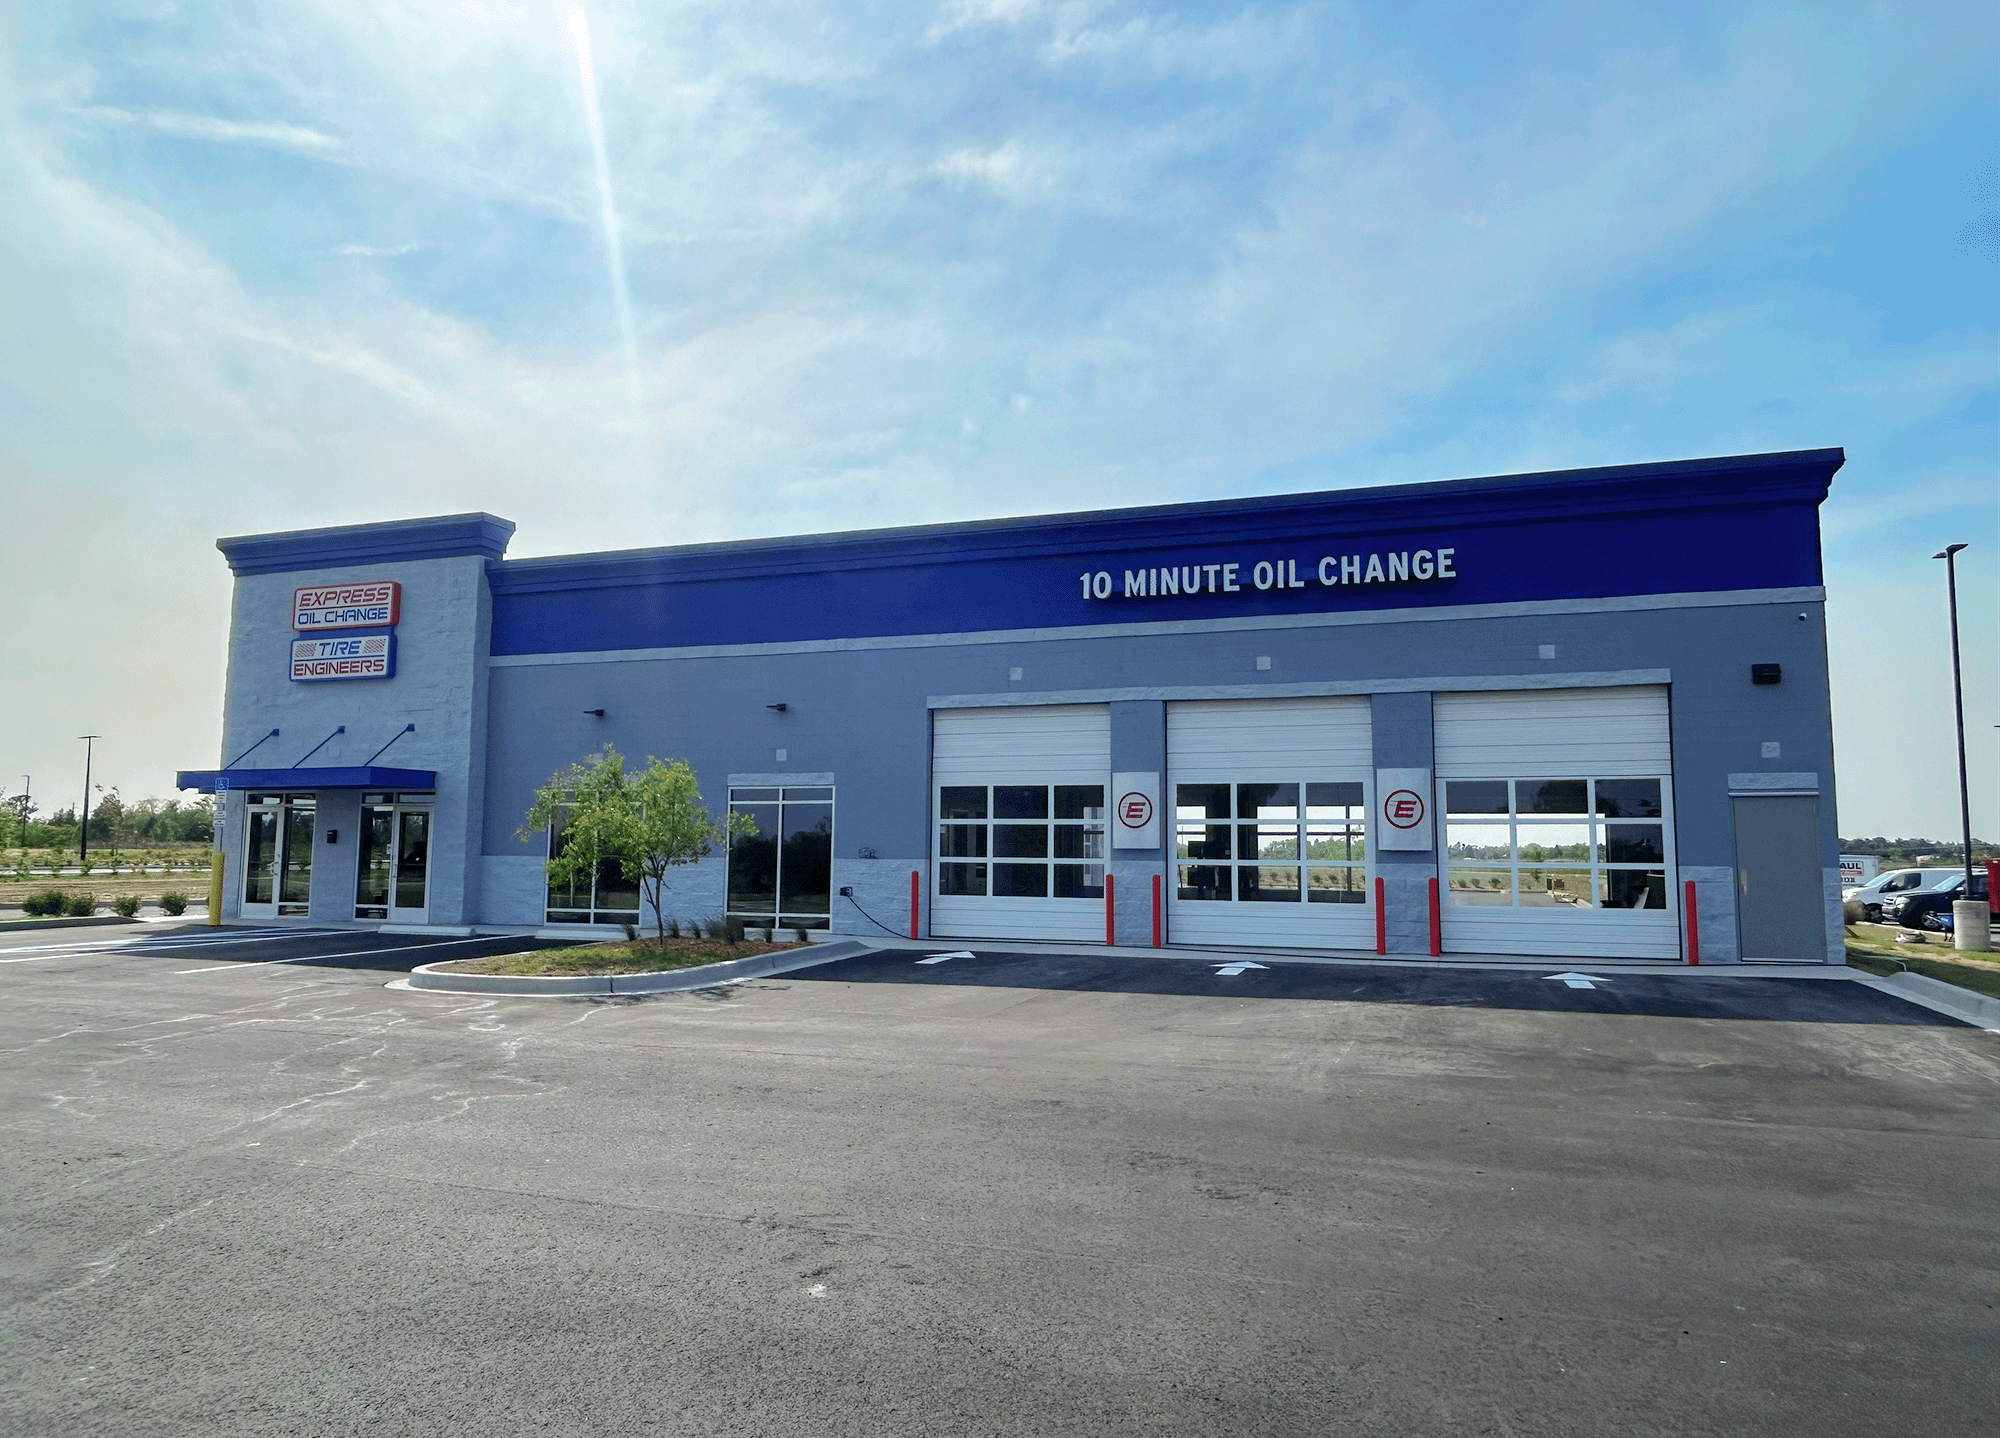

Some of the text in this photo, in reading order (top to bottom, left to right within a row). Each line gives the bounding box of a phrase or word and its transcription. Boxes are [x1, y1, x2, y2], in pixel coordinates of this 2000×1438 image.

[1079, 548, 1457, 600] 10 MINUTE OIL CHANGE
[299, 586, 391, 607] EXPRESS
[298, 607, 389, 625] OIL CHANGE
[319, 640, 362, 656] TIRE
[293, 659, 385, 676] ENGINEERS
[1125, 802, 1146, 818] E
[1394, 800, 1417, 818] E
